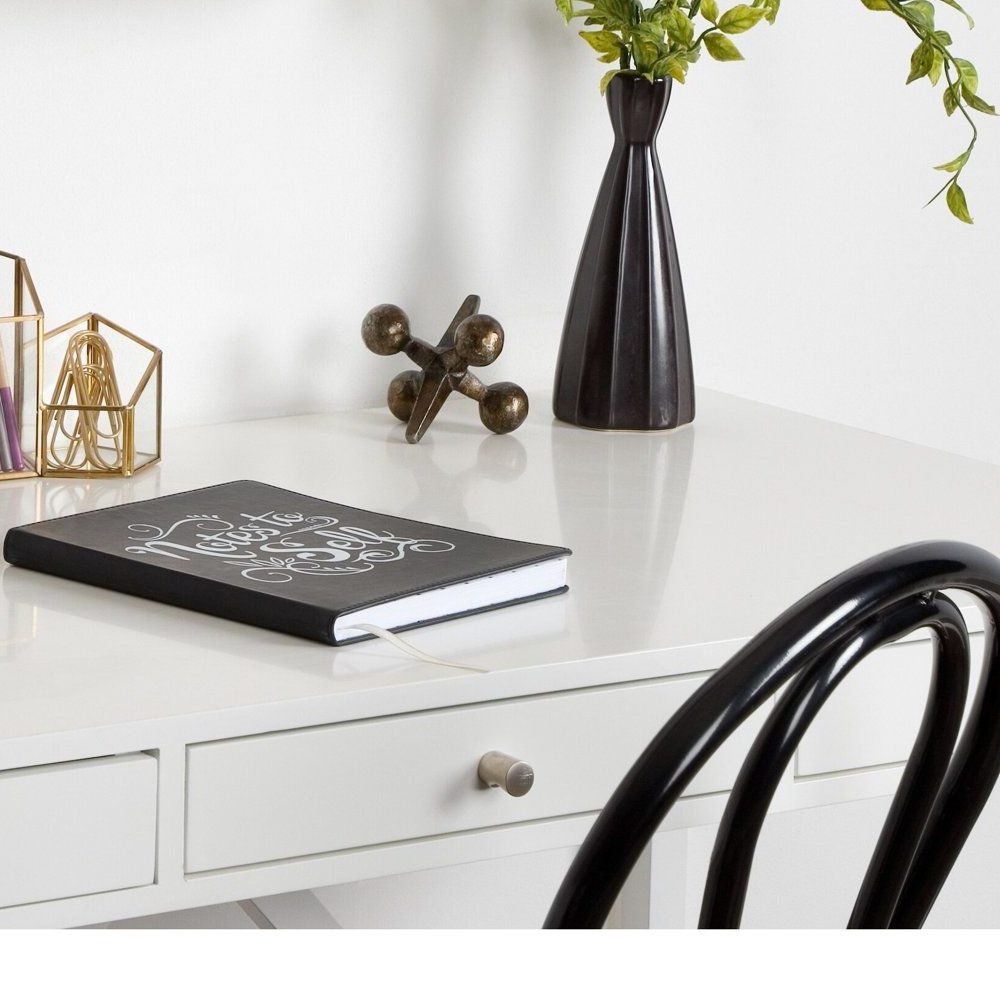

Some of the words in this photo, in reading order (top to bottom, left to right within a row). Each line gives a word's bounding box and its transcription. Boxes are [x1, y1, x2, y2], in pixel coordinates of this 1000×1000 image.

[125, 523, 281, 561] Notes
[240, 511, 304, 527] to
[259, 526, 418, 563] Self
